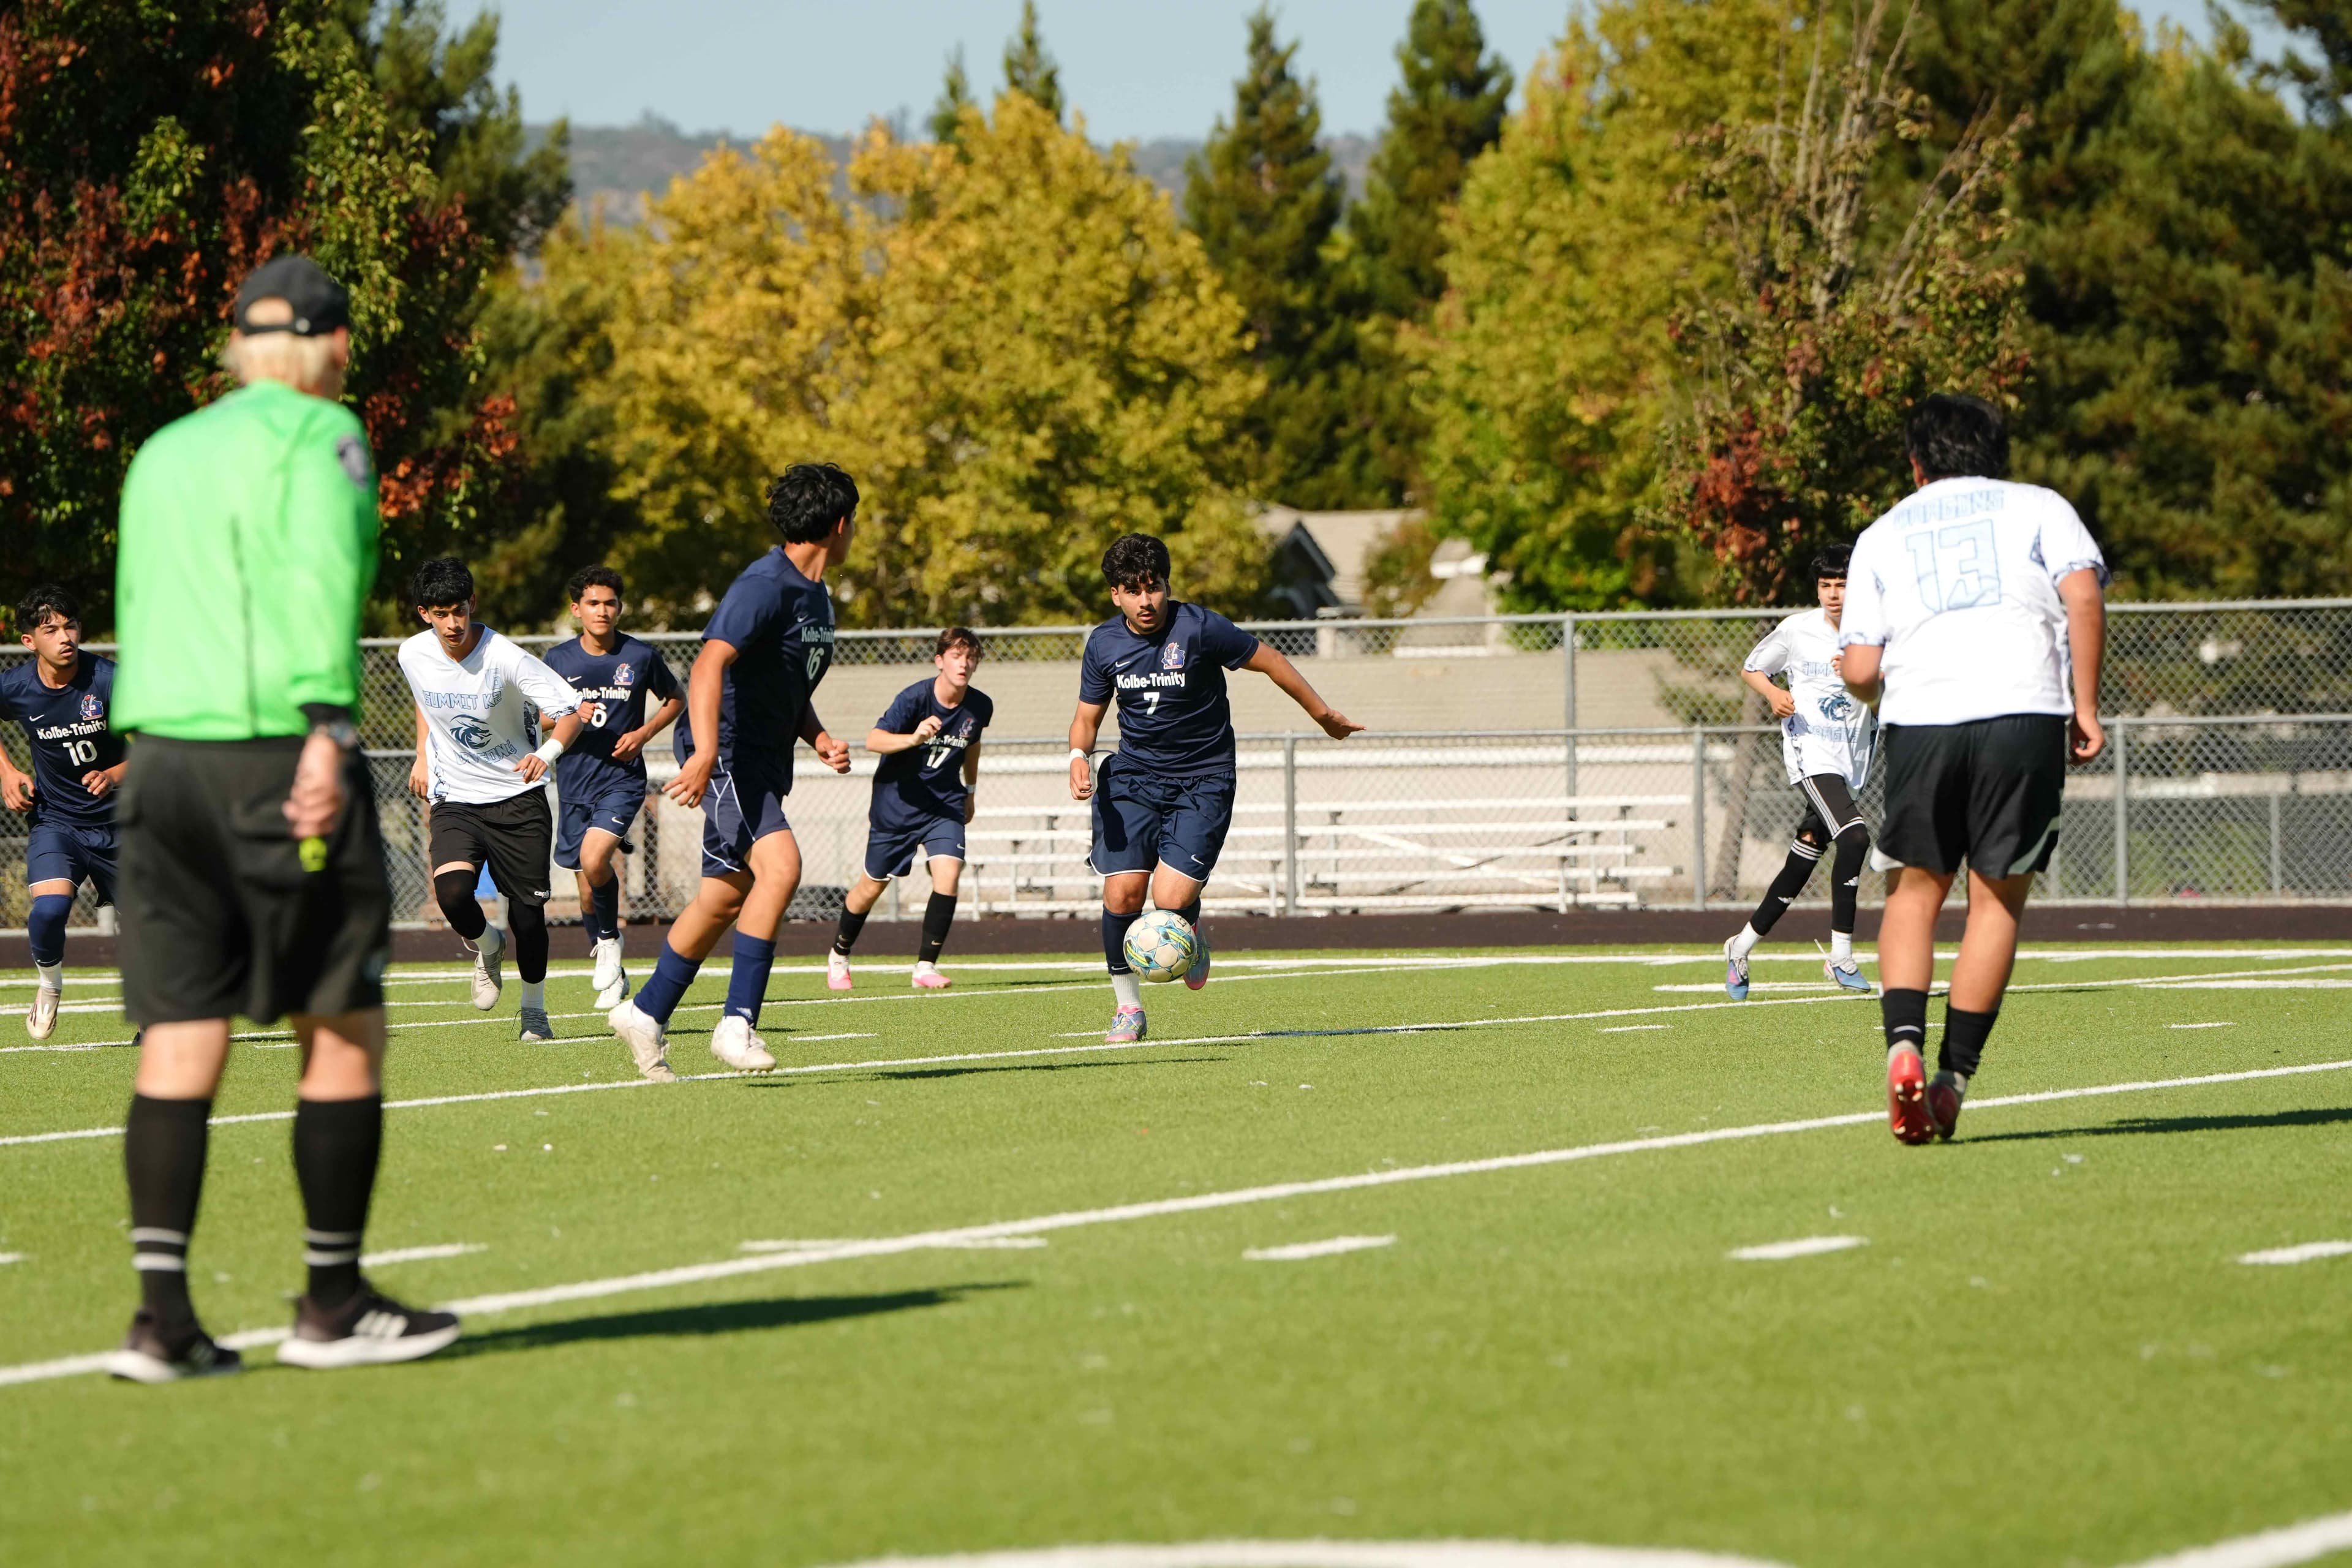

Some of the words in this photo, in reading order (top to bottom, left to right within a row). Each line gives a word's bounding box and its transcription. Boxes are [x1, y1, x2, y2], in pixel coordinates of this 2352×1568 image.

[1905, 519, 2001, 615] 13
[807, 647, 824, 680] 16
[1116, 671, 1185, 688] Kolbe-Trinity
[423, 690, 478, 710] SUMMIT
[483, 691, 502, 709] K2
[576, 687, 631, 702] olbe-Trinity
[1143, 692, 1160, 715] 7
[591, 702, 608, 728] 6
[36, 720, 107, 740] Kolbe-Trinity
[62, 740, 97, 766] 10
[927, 745, 951, 769] 17
